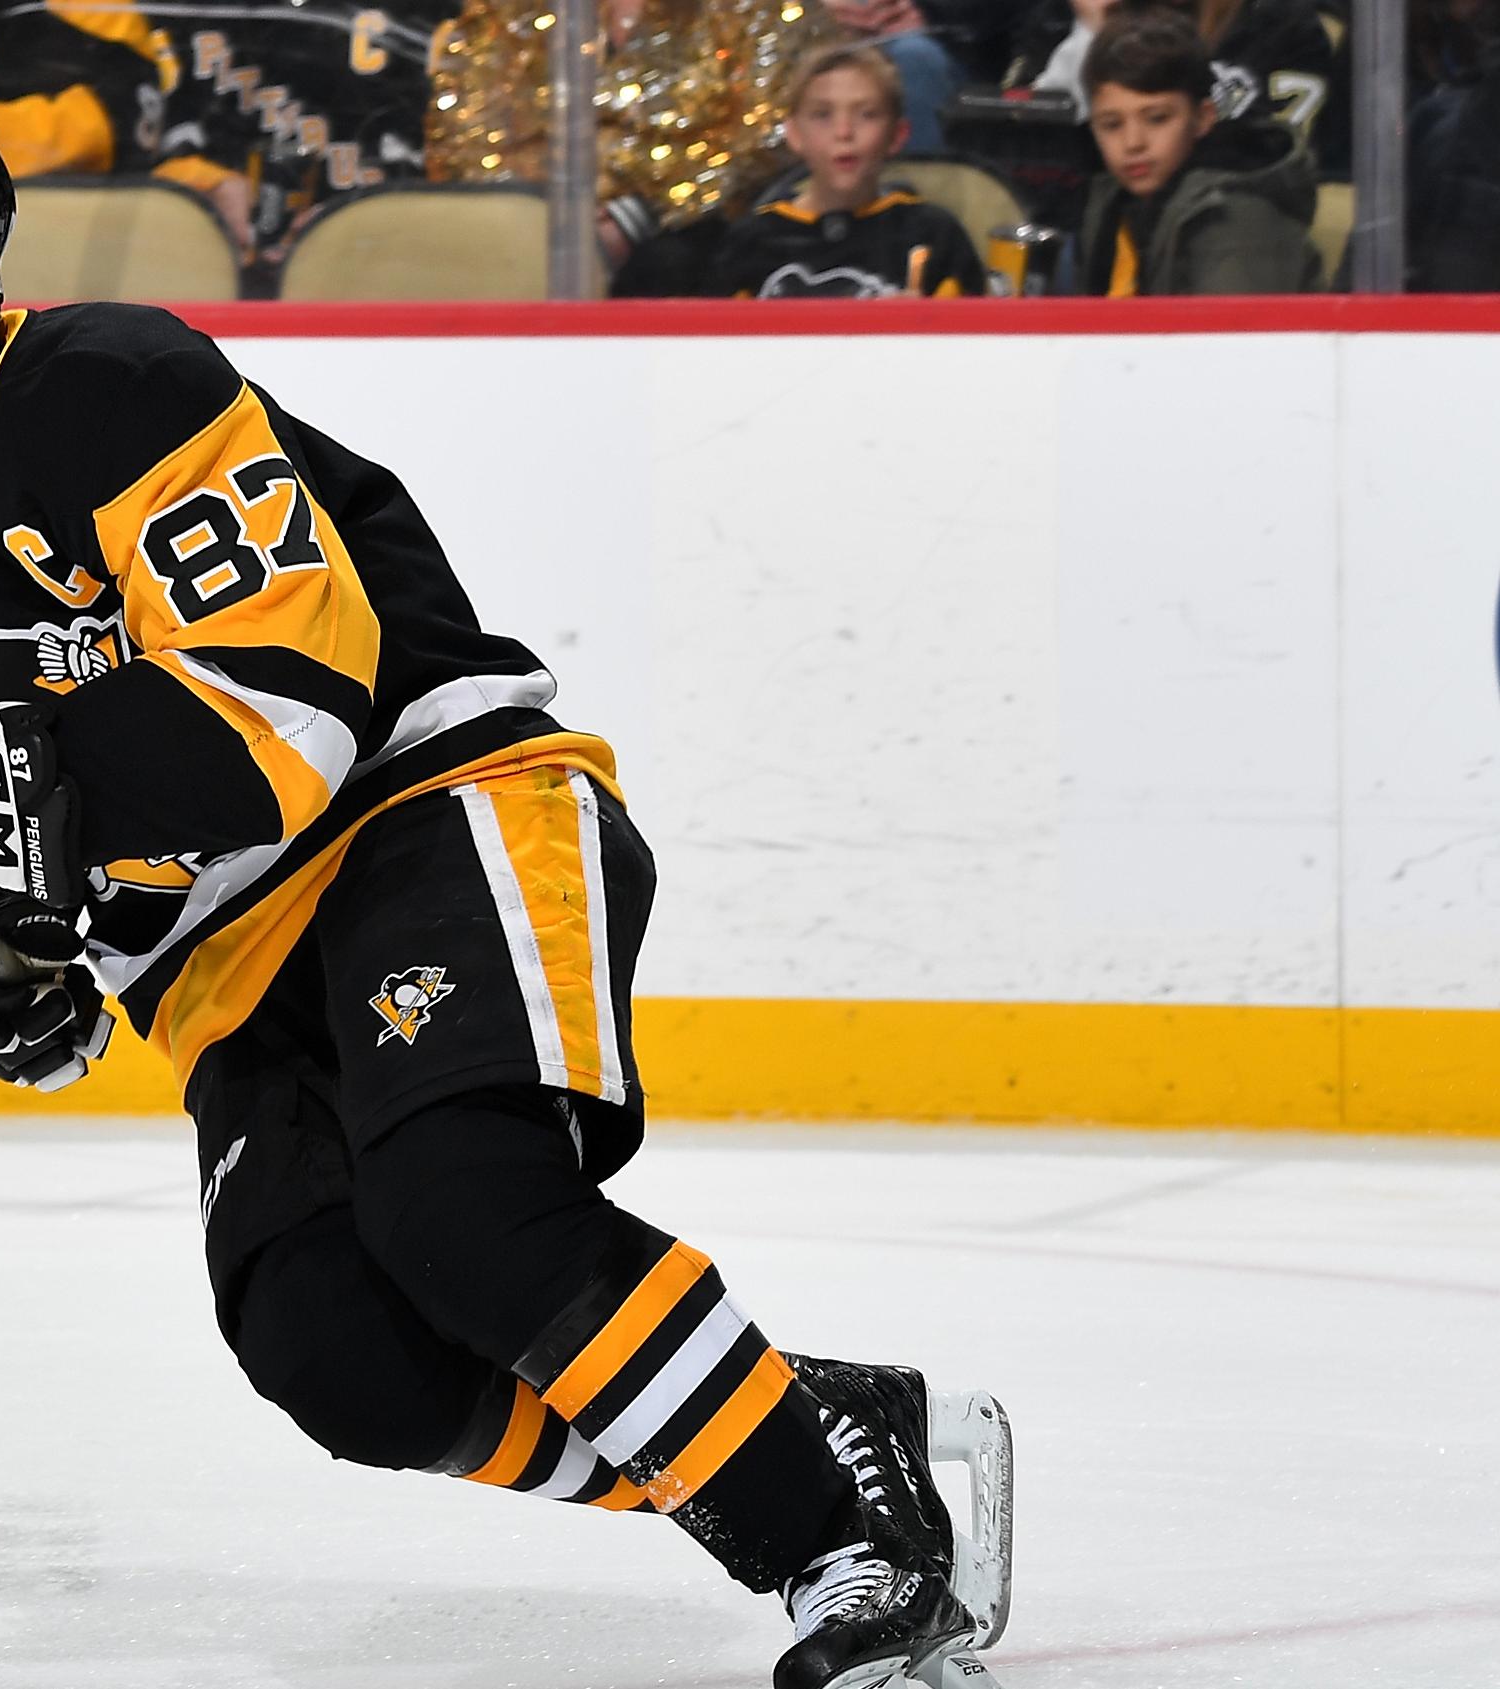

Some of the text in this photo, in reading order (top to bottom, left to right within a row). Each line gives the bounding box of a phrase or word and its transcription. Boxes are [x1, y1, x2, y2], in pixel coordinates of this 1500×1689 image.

[2, 524, 106, 609] C
[137, 452, 330, 629] 87
[9, 747, 33, 783] 87
[25, 815, 49, 901] PENGUINS
[894, 1572, 923, 1607] CCM
